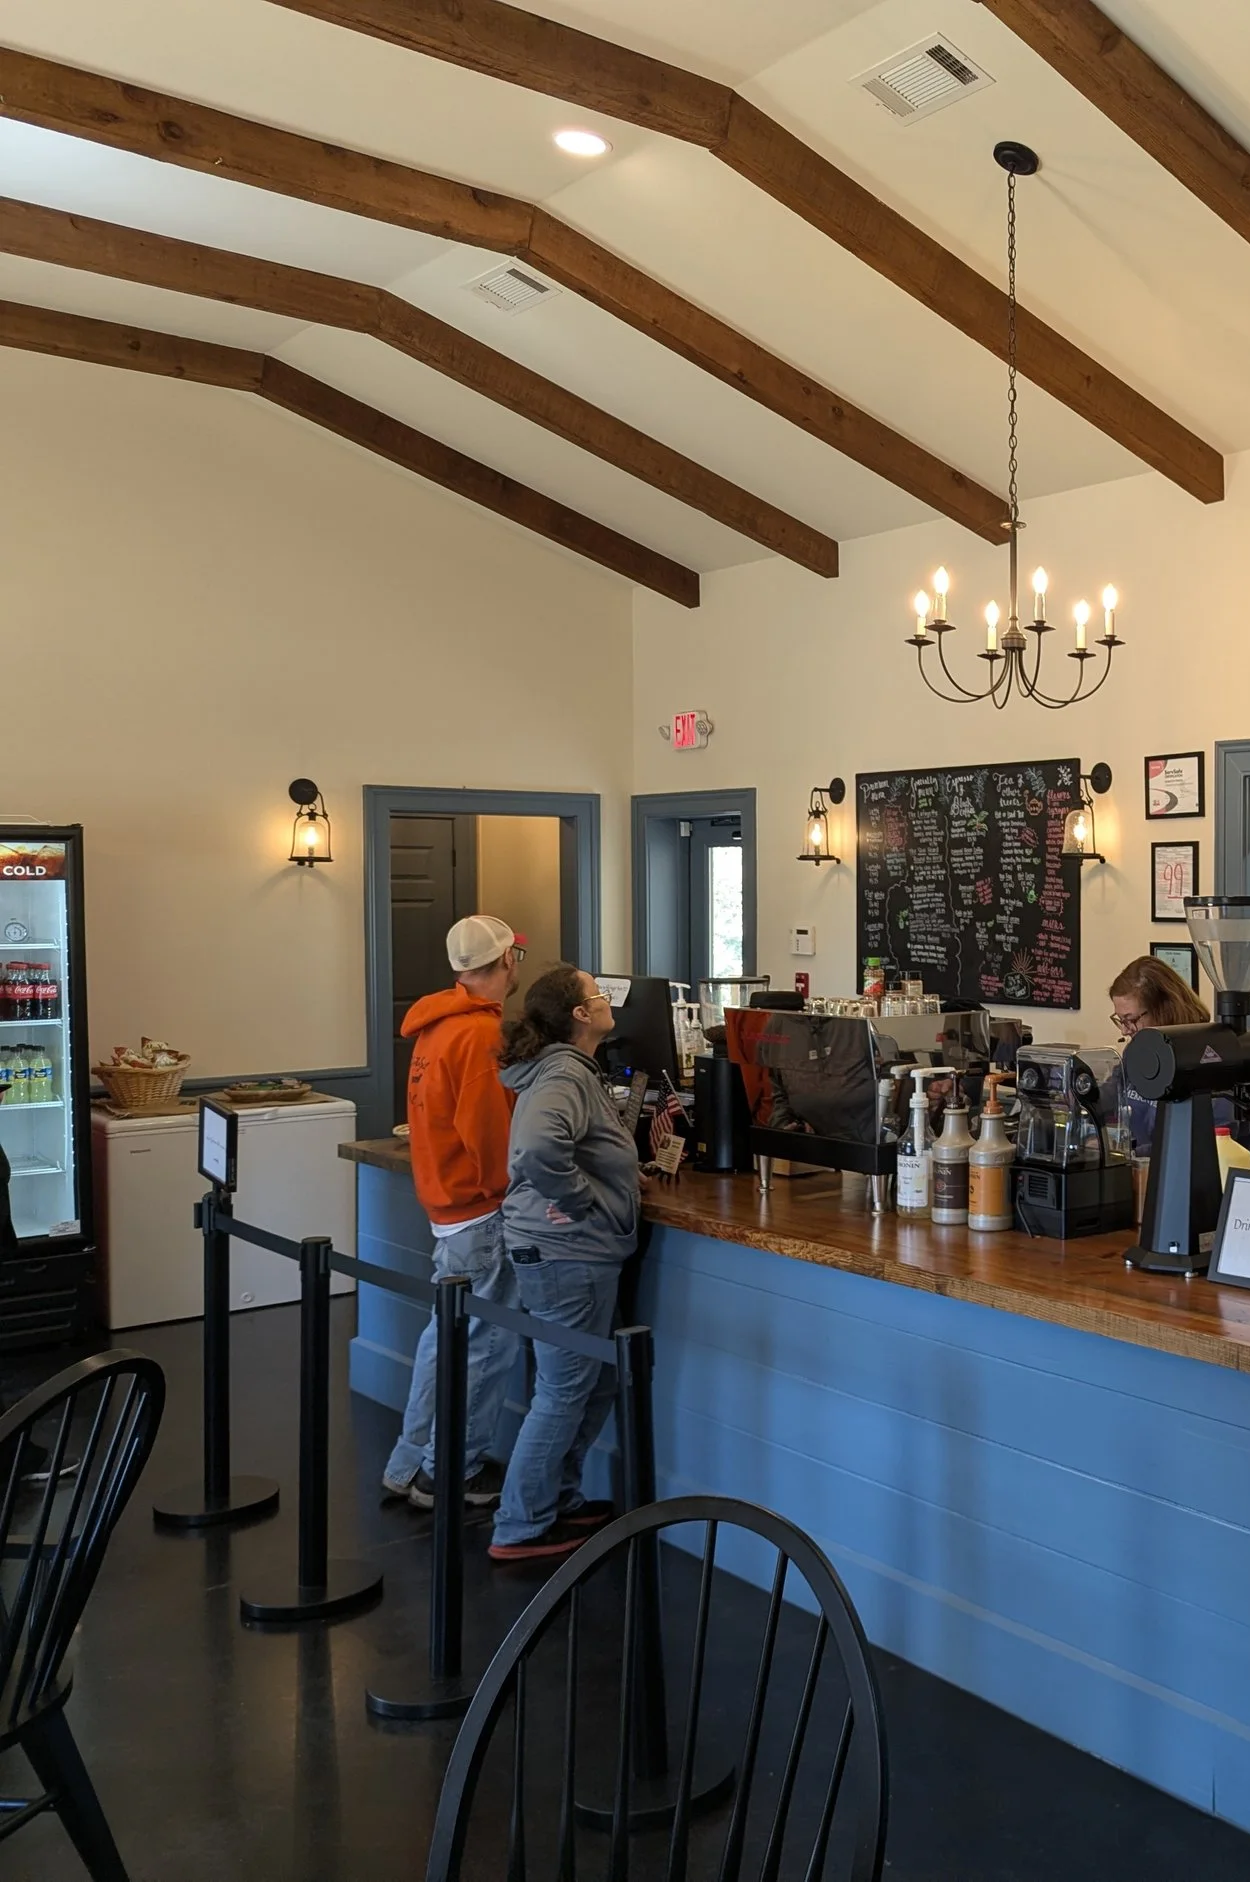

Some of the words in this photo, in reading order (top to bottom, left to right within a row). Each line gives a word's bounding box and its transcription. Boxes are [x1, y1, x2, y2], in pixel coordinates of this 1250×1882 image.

[675, 713, 696, 748] EXIT
[992, 772, 1015, 793] Tea
[3, 865, 47, 876] COLD
[1163, 863, 1184, 897] 99
